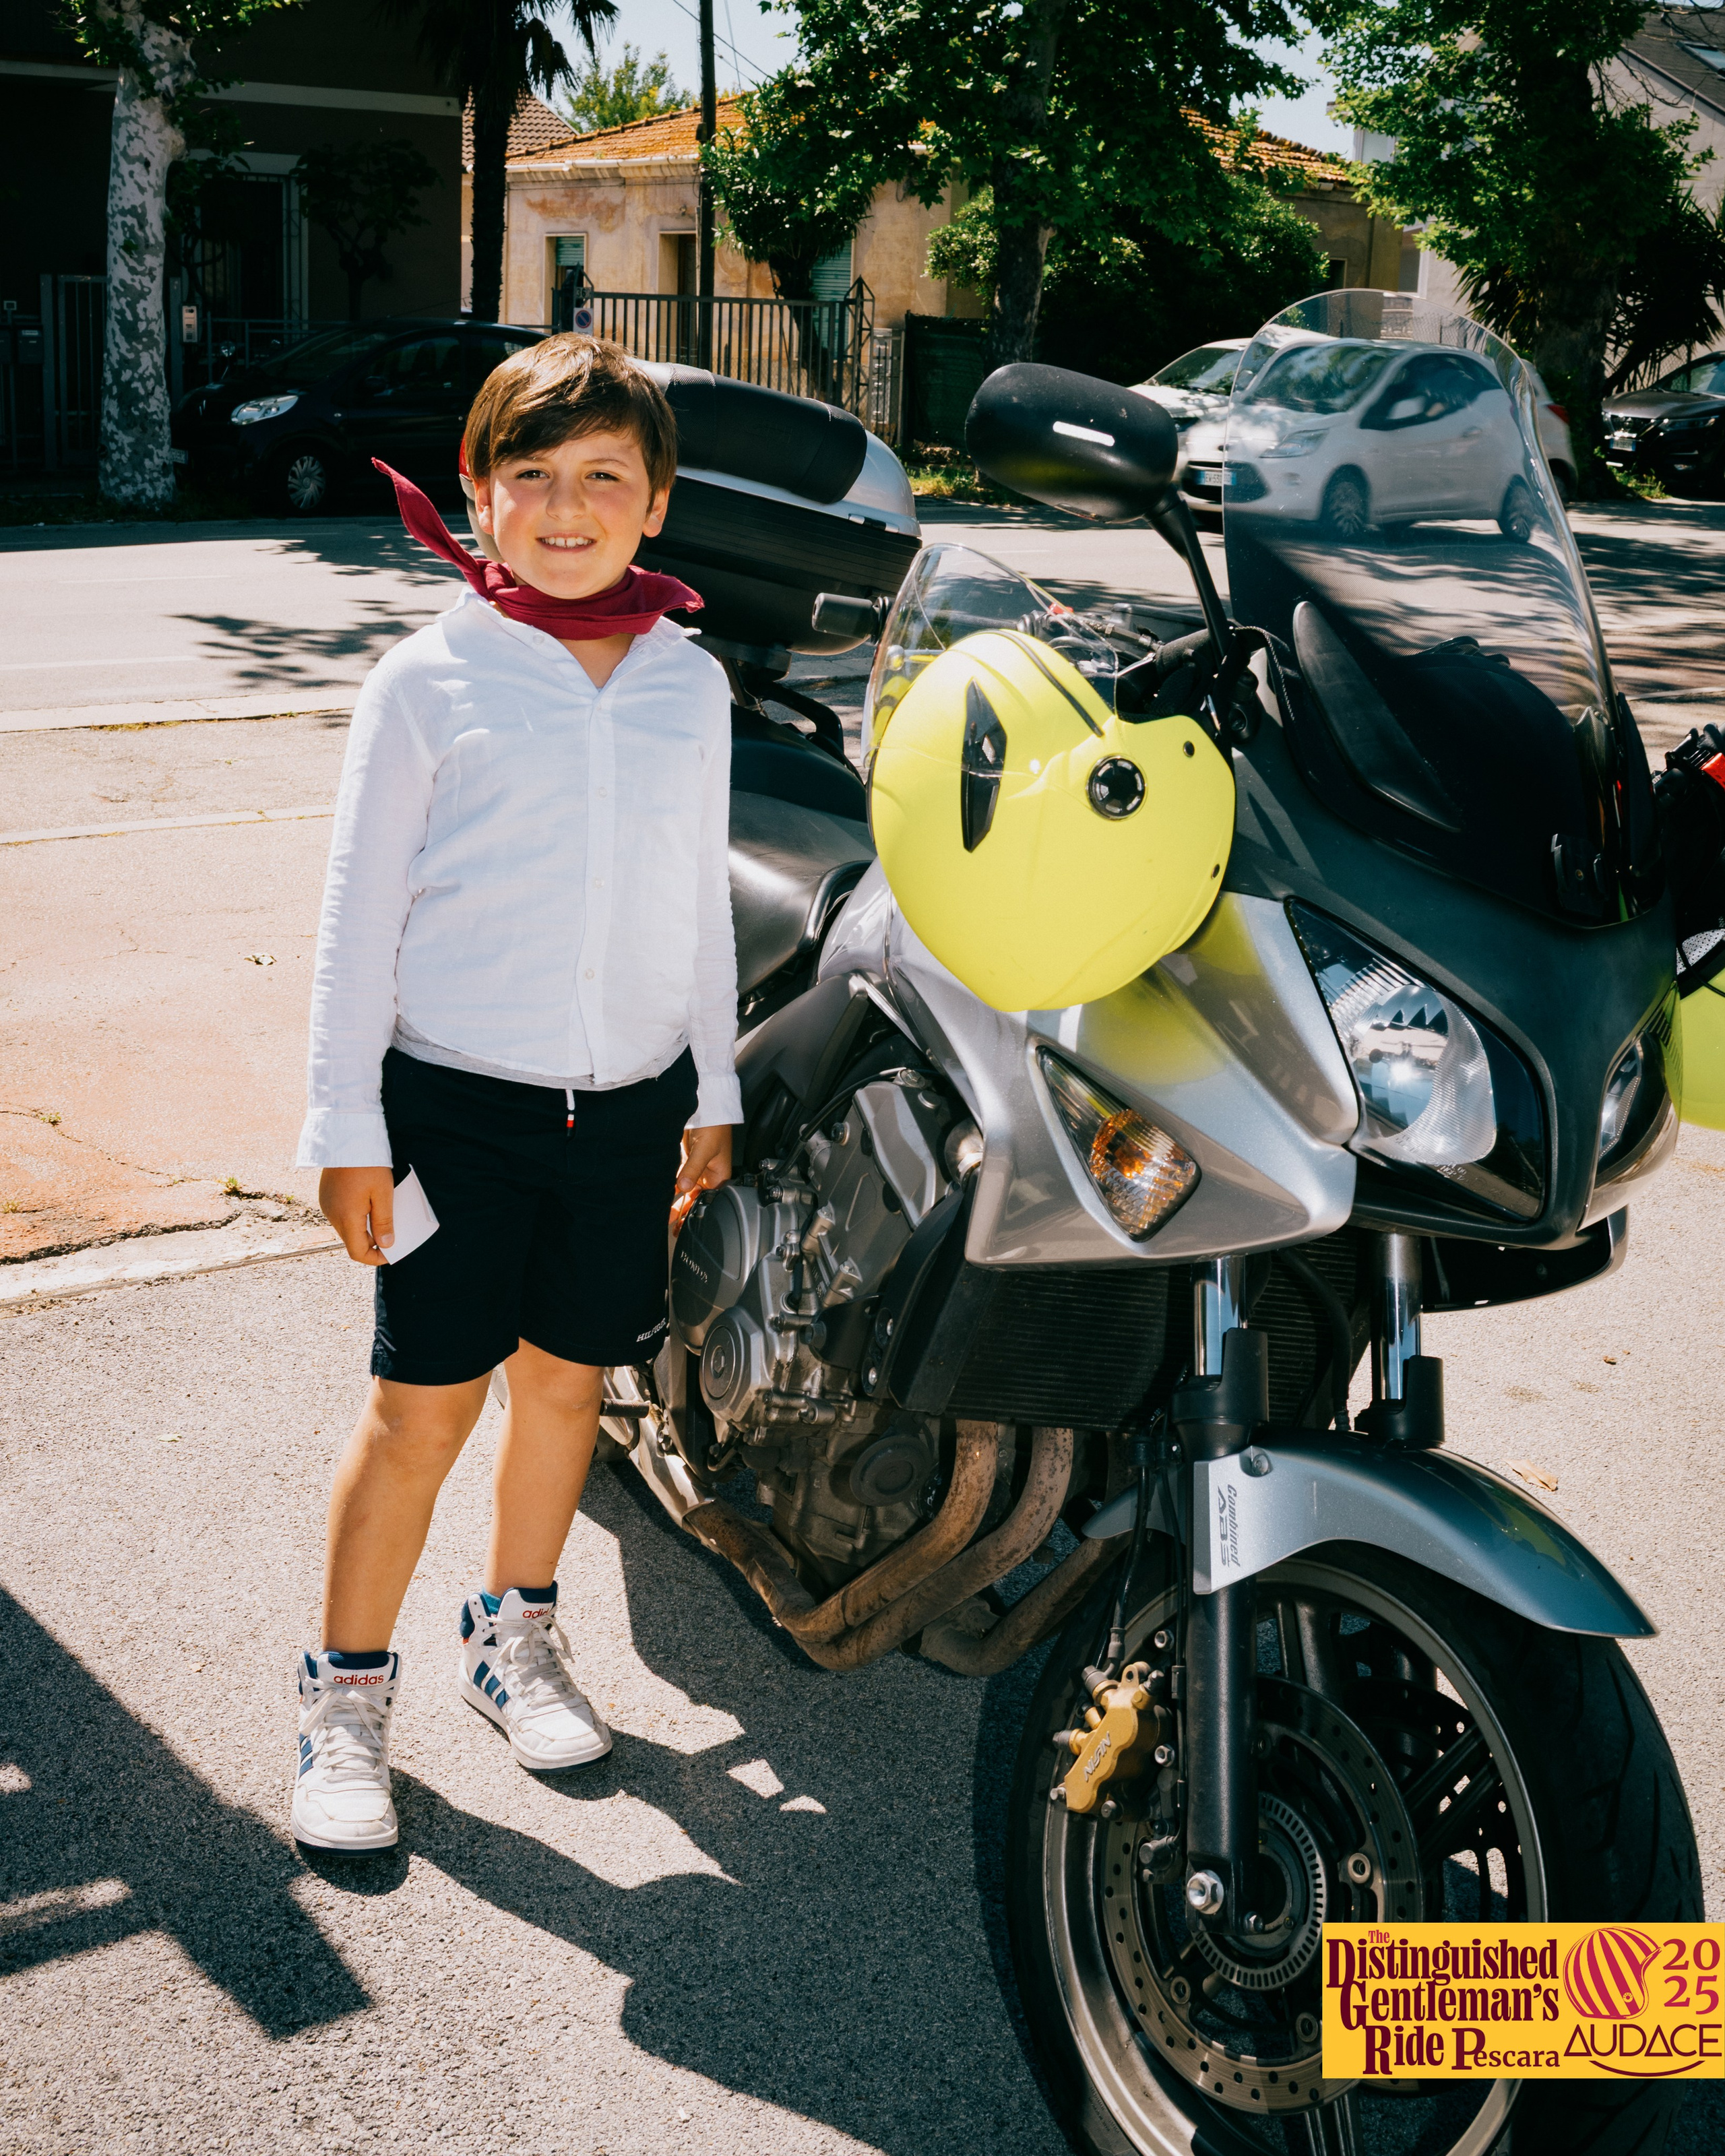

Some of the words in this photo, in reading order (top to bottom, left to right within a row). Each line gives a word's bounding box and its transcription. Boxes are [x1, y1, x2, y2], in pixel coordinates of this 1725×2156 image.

[1217, 1485, 1230, 1568] ABS
[1227, 1484, 1241, 1567] Combined
[522, 1608, 550, 1618] adid
[334, 1674, 384, 1685] adidas
